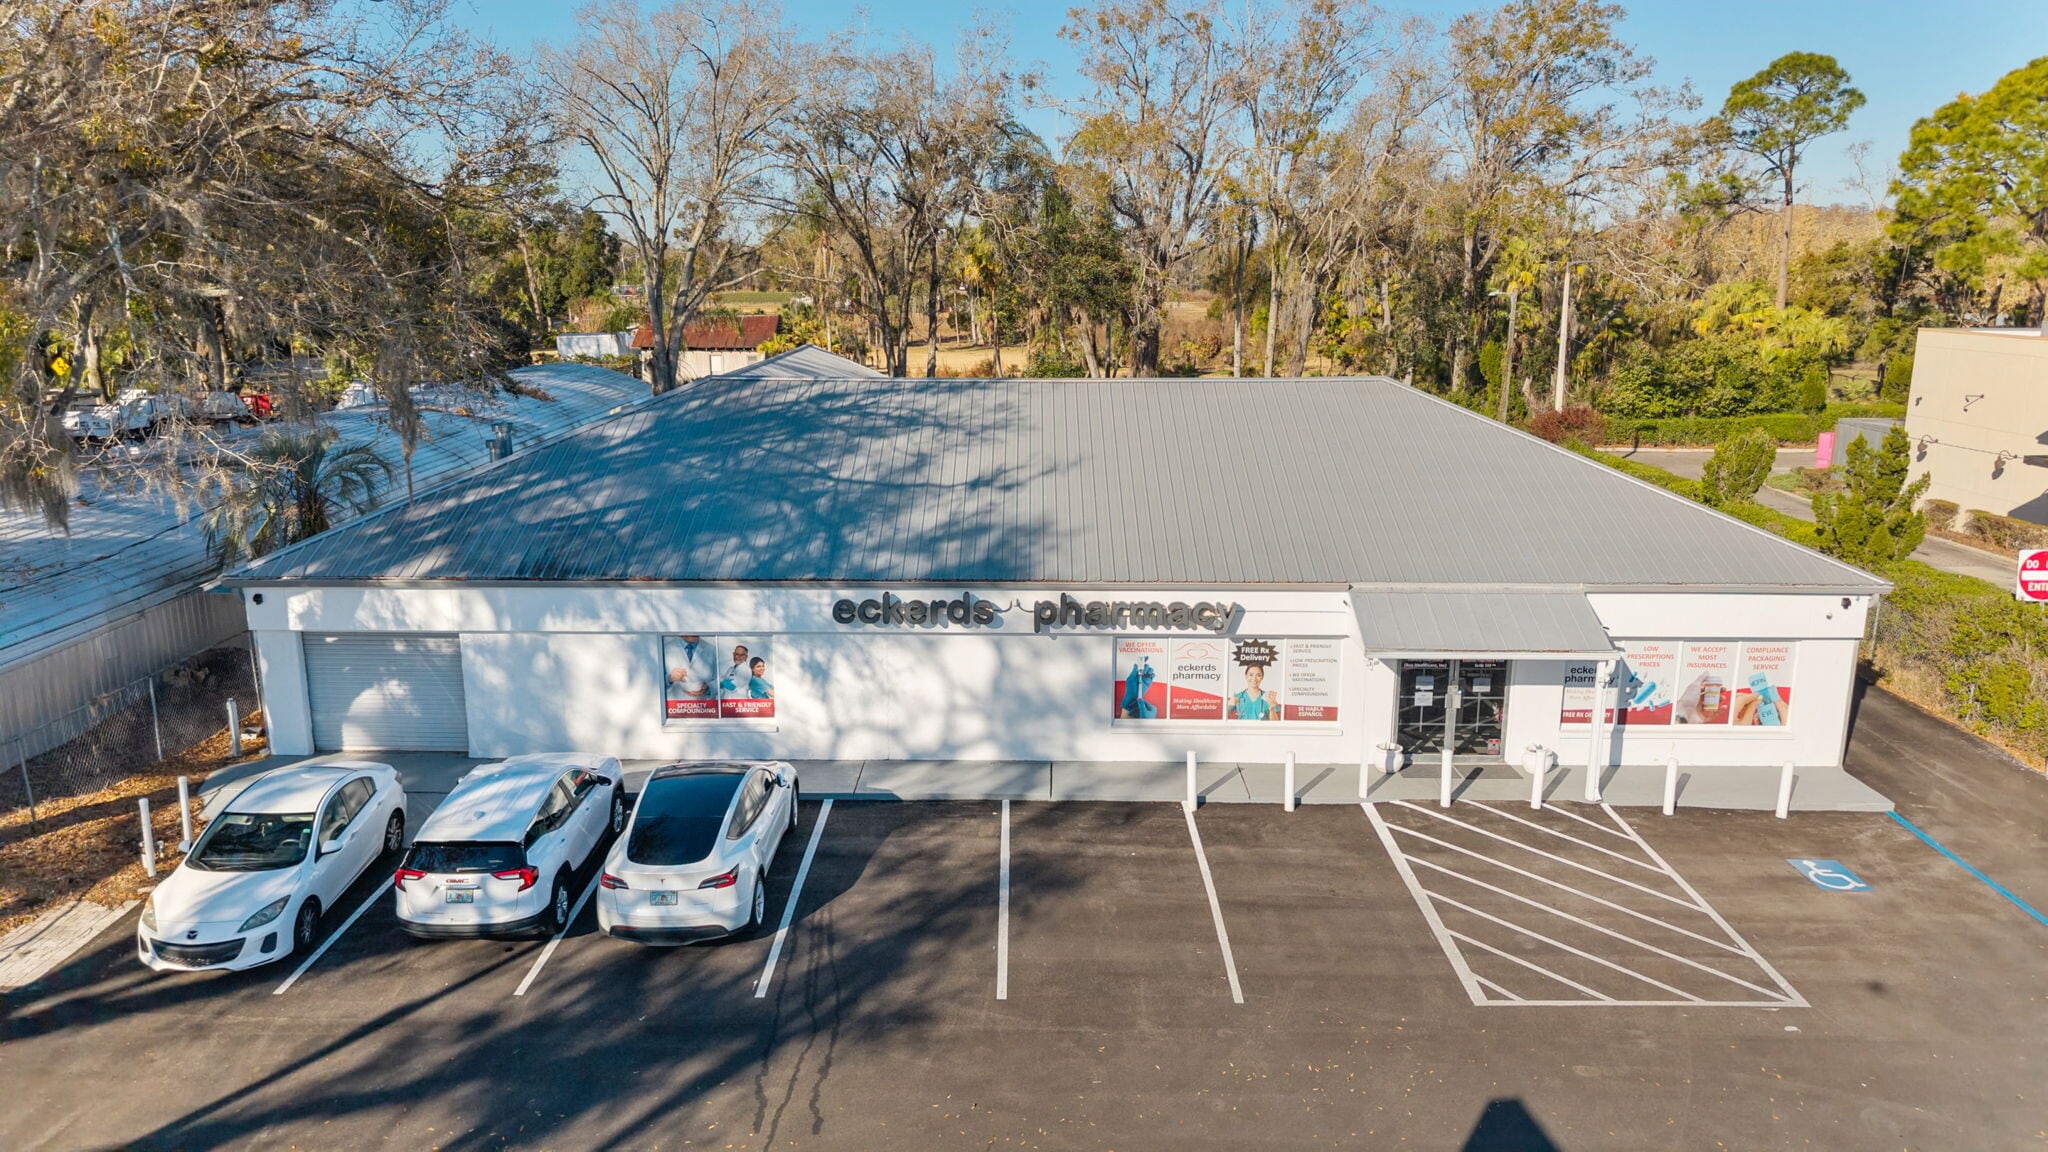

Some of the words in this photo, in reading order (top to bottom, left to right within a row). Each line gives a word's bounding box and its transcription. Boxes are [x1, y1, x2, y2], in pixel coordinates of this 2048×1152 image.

[2026, 560, 2039, 569] DO
[2027, 582, 2048, 592] ENT
[832, 591, 994, 626] eckerds
[1034, 592, 1238, 634] pharmacy
[1240, 654, 1270, 662] Delivery
[1177, 663, 1217, 672] eckerds
[1570, 665, 1597, 674] ecke
[1172, 672, 1221, 681] pharmacy
[1564, 675, 1615, 685] pharmy
